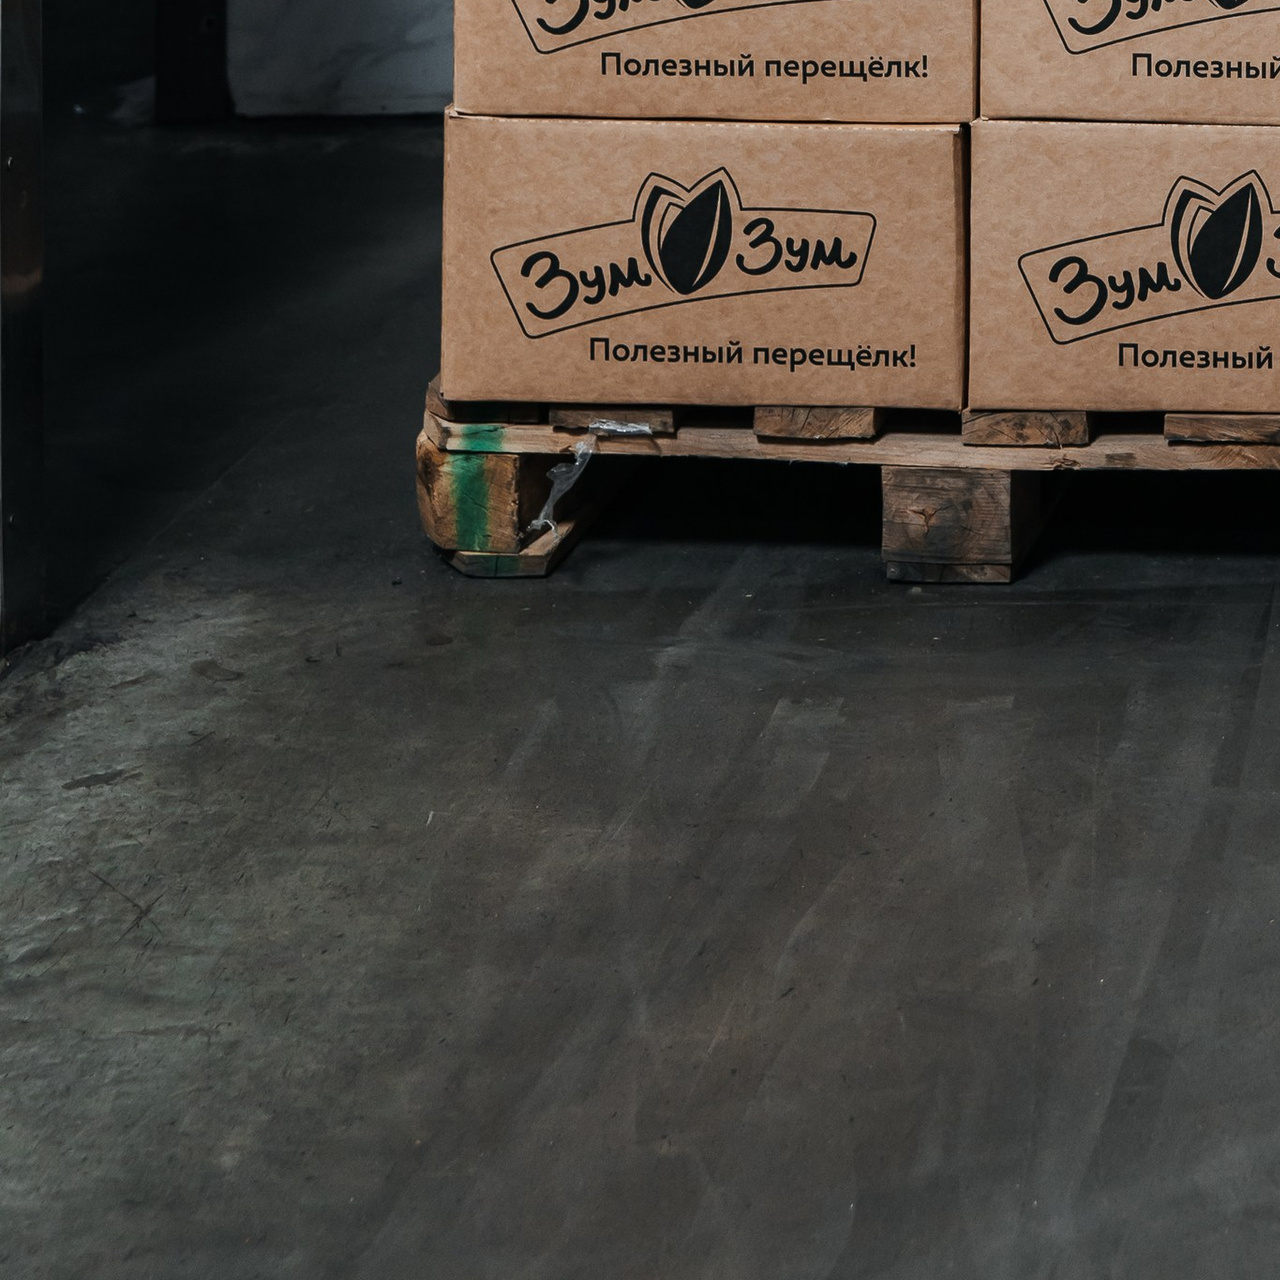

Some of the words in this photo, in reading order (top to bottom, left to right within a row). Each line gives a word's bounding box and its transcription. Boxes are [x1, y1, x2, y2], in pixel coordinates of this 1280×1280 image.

[601, 51, 755, 77] Полезный
[765, 54, 928, 85] перещёлк!
[520, 250, 653, 320] Зум
[735, 217, 858, 276] Зум
[1048, 255, 1182, 326] Зум
[589, 337, 743, 364] Полезный
[753, 344, 916, 373] перещёлк!
[1118, 342, 1273, 370] Полезный
